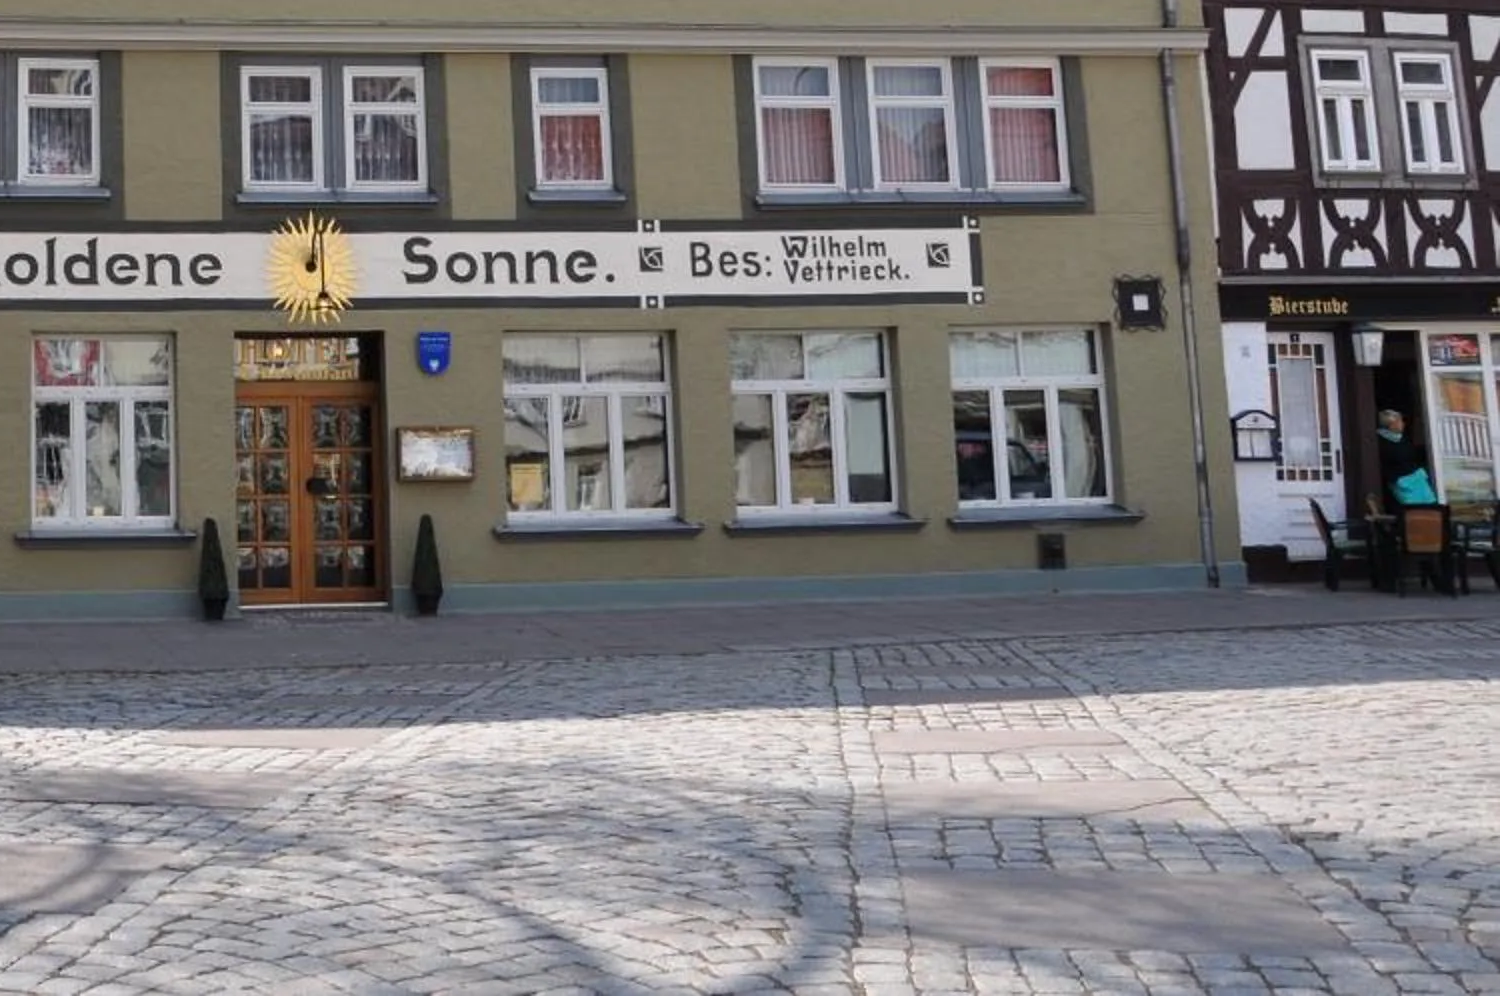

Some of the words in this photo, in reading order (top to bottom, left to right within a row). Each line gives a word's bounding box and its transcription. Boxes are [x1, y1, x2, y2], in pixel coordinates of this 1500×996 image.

[781, 235, 886, 258] Wilhelm
[403, 236, 615, 284] Sonne.
[689, 241, 772, 278] Bes:
[783, 259, 910, 284] Vettrieck.
[1269, 295, 1349, 316] Bierstube
